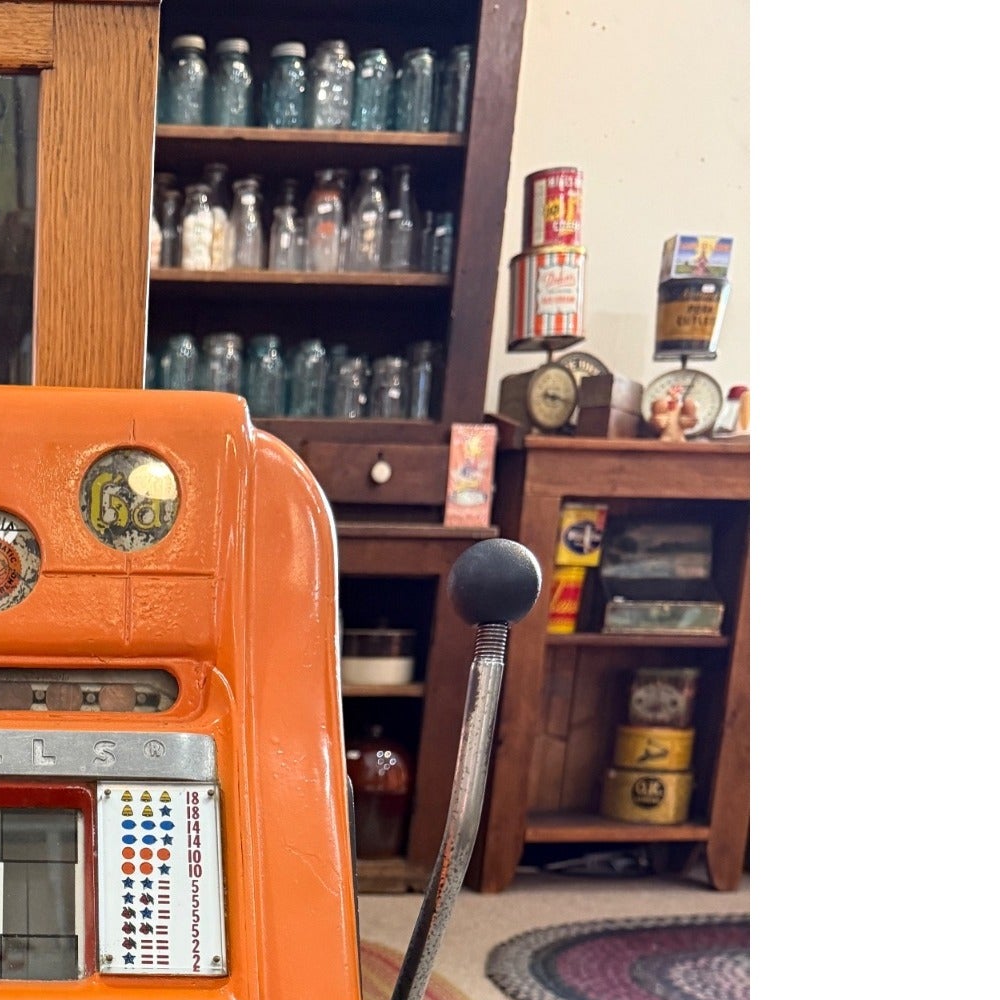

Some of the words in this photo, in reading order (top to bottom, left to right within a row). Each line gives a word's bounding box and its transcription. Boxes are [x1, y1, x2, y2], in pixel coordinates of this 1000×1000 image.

[186, 791, 199, 804] 18
[186, 806, 199, 820] 18
[187, 821, 200, 834] 14
[187, 835, 201, 848] 14
[188, 850, 201, 863] 10
[188, 864, 202, 877] 10
[192, 880, 199, 893] 5
[192, 895, 199, 908] 5
[192, 910, 199, 922] 5
[191, 924, 199, 937] 5
[192, 939, 199, 953] 2
[193, 955, 200, 968] 2
